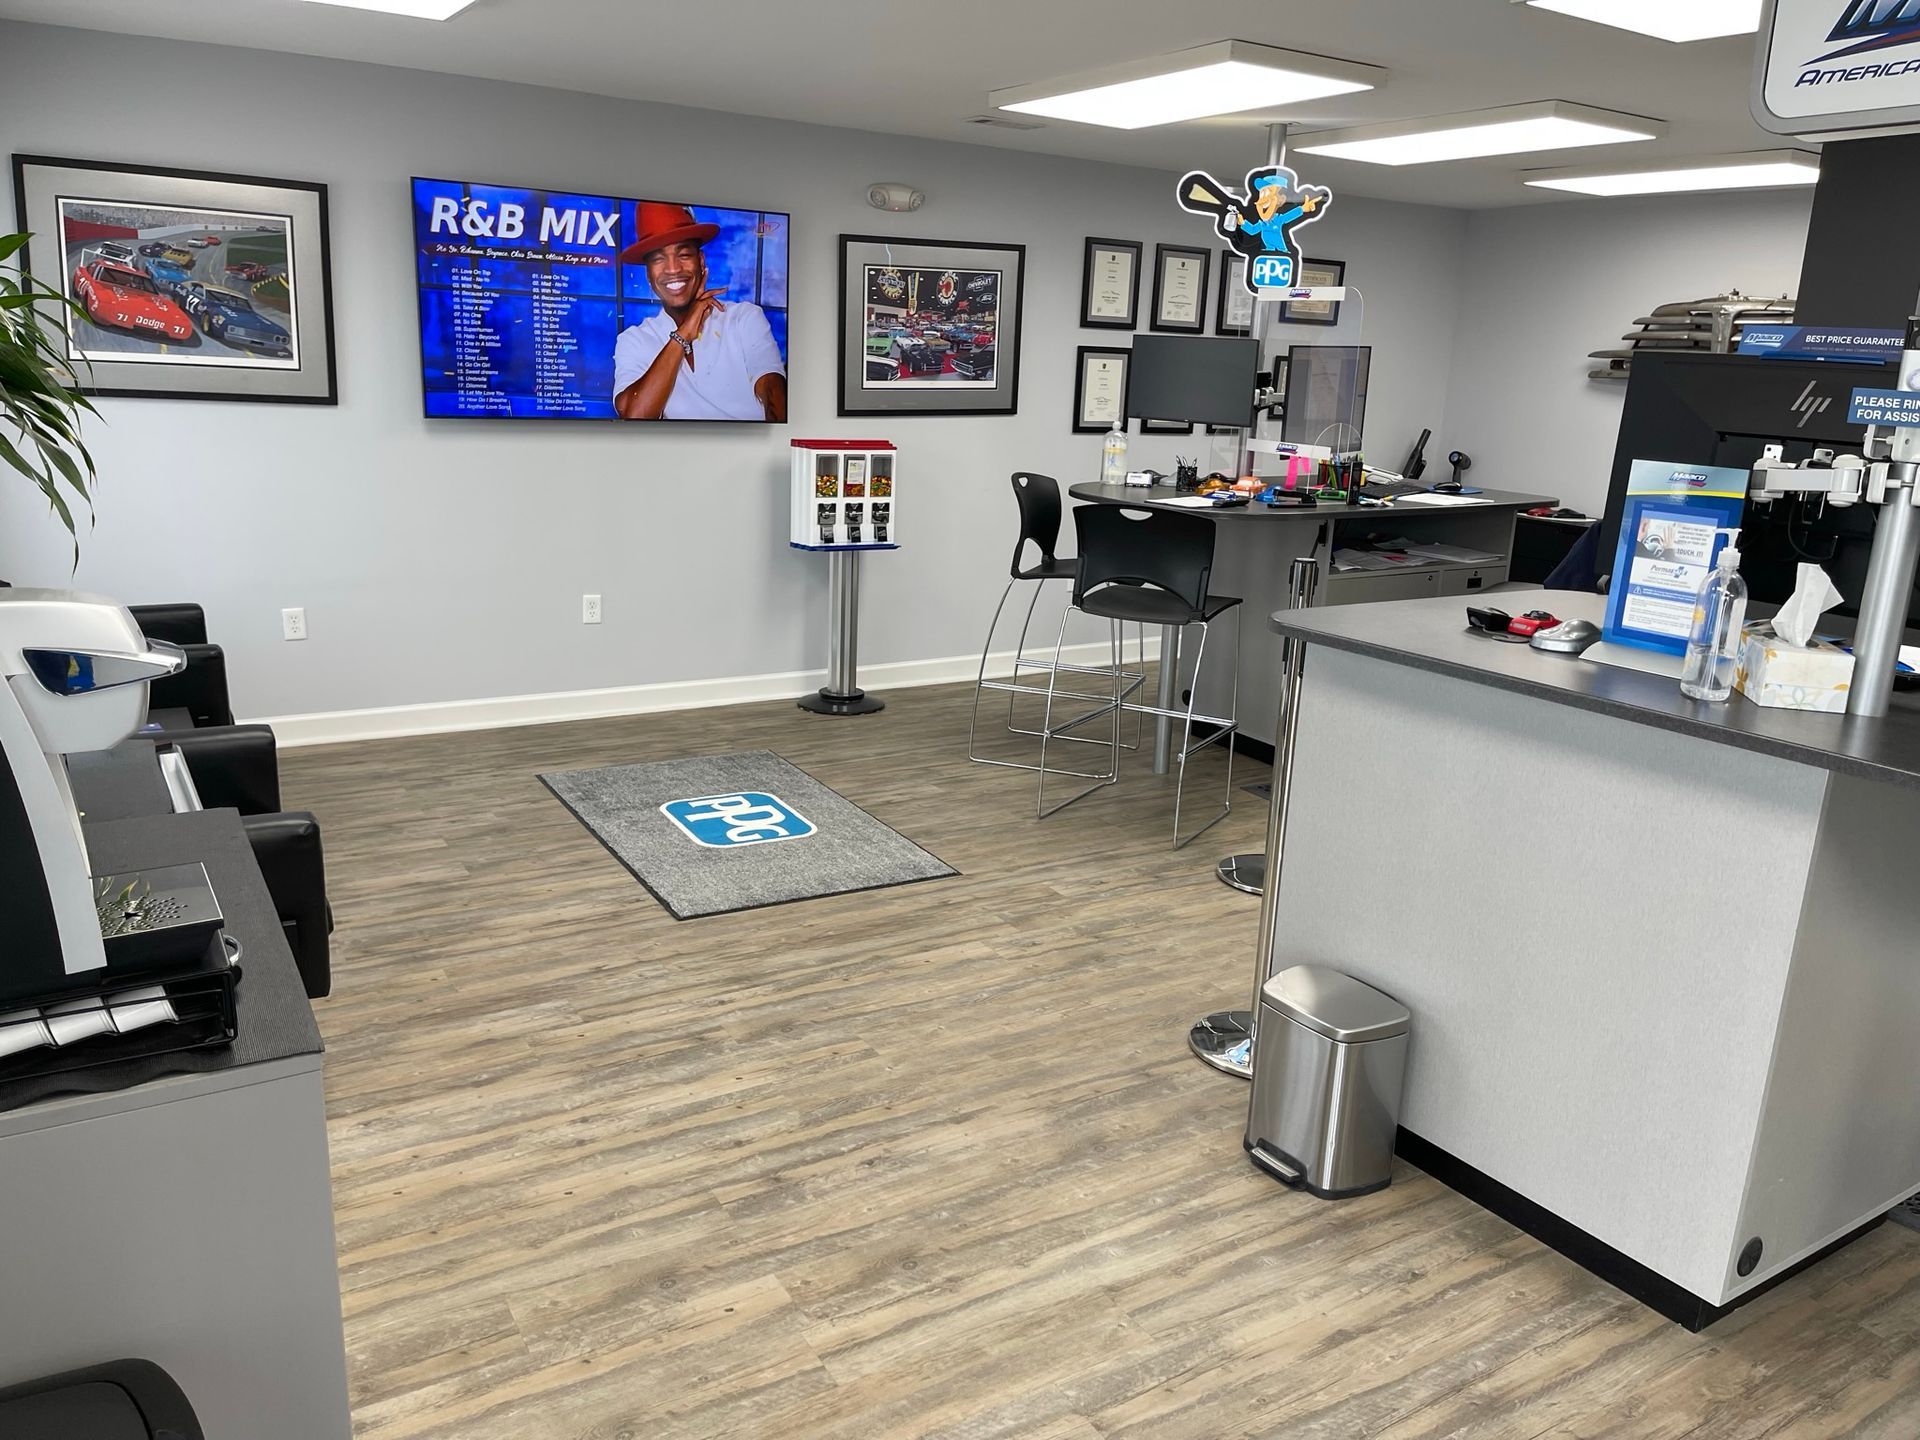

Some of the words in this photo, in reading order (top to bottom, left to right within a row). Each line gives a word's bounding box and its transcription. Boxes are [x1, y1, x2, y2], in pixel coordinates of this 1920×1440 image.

[1794, 59, 1920, 88] AMERICA
[430, 197, 524, 239] R&B
[539, 207, 620, 247] MIX
[1255, 260, 1290, 284] PPG
[185, 294, 201, 314] 17
[117, 313, 129, 322] 71
[135, 315, 166, 329] Dodge
[173, 325, 185, 335] 71
[1805, 334, 1827, 344] BEST
[1827, 335, 1853, 345] PRICE
[1855, 336, 1905, 347] GUARANTEE
[1791, 380, 1832, 428] hp
[1854, 395, 1902, 408] PLEASE
[1856, 409, 1881, 420] FOR
[1883, 411, 1920, 423] ASSIS
[684, 796, 790, 842] PPG
